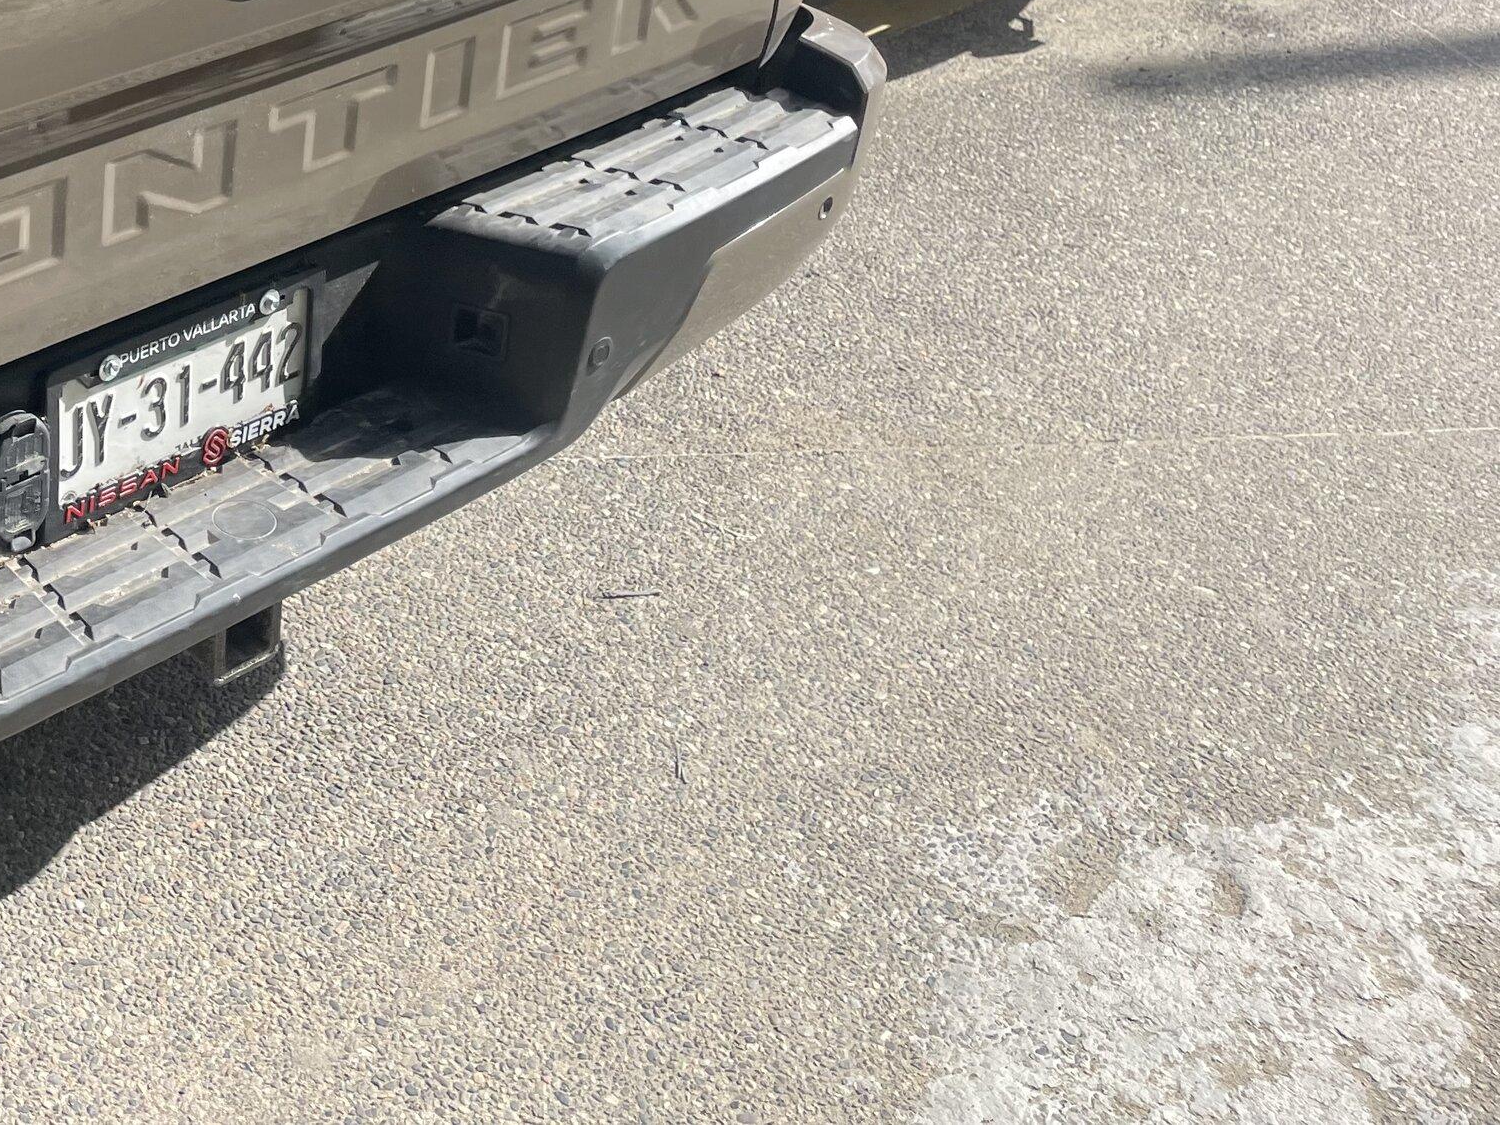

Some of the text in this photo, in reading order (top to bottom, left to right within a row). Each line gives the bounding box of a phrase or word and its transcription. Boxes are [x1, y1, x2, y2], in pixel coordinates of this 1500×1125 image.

[120, 302, 257, 365] PUERTO VALLARTA
[59, 322, 301, 477] JY-31-442
[65, 401, 299, 523] NISSAN SIERRA
